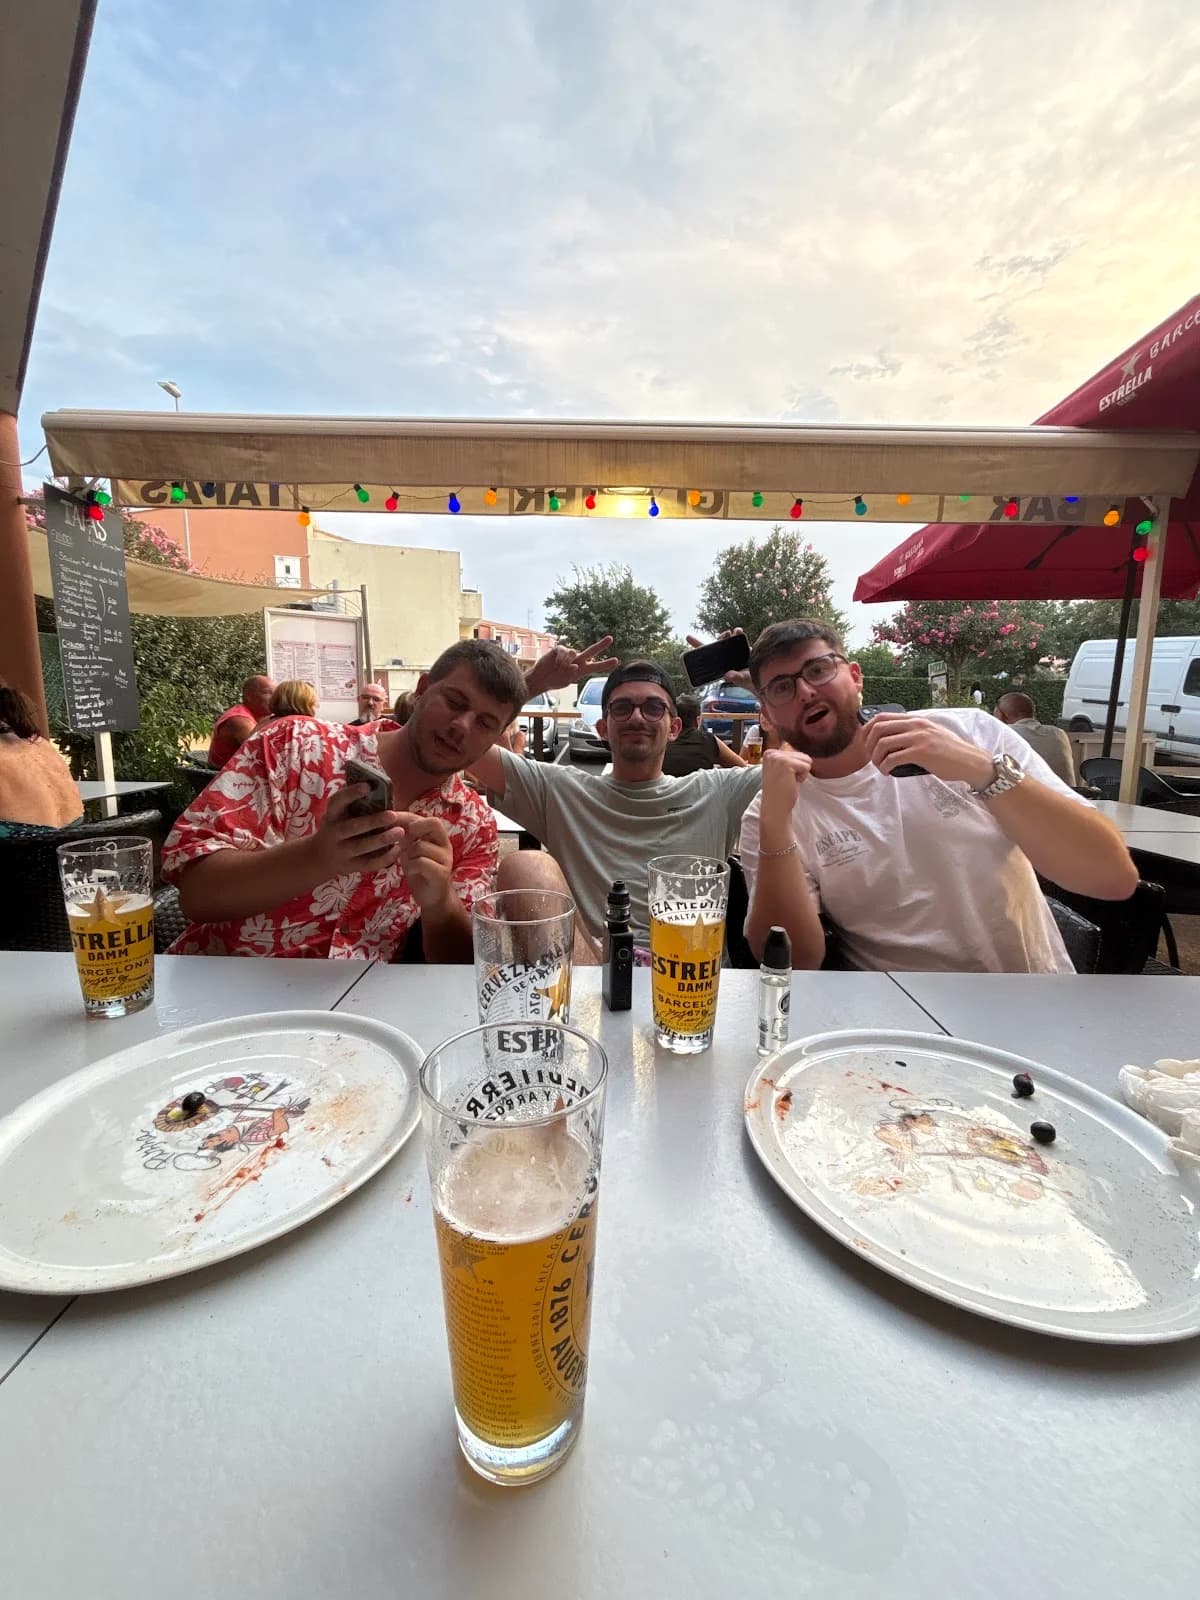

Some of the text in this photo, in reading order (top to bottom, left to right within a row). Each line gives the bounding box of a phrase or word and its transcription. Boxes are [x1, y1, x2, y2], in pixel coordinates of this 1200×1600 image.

[1099, 366, 1153, 412] ESTRELLA
[88, 948, 129, 961] DAMM
[480, 958, 537, 1010] CERVEZA
[677, 981, 713, 992] DAMM
[535, 1233, 564, 1293] CHICAGO
[550, 1278, 572, 1333] 1876
